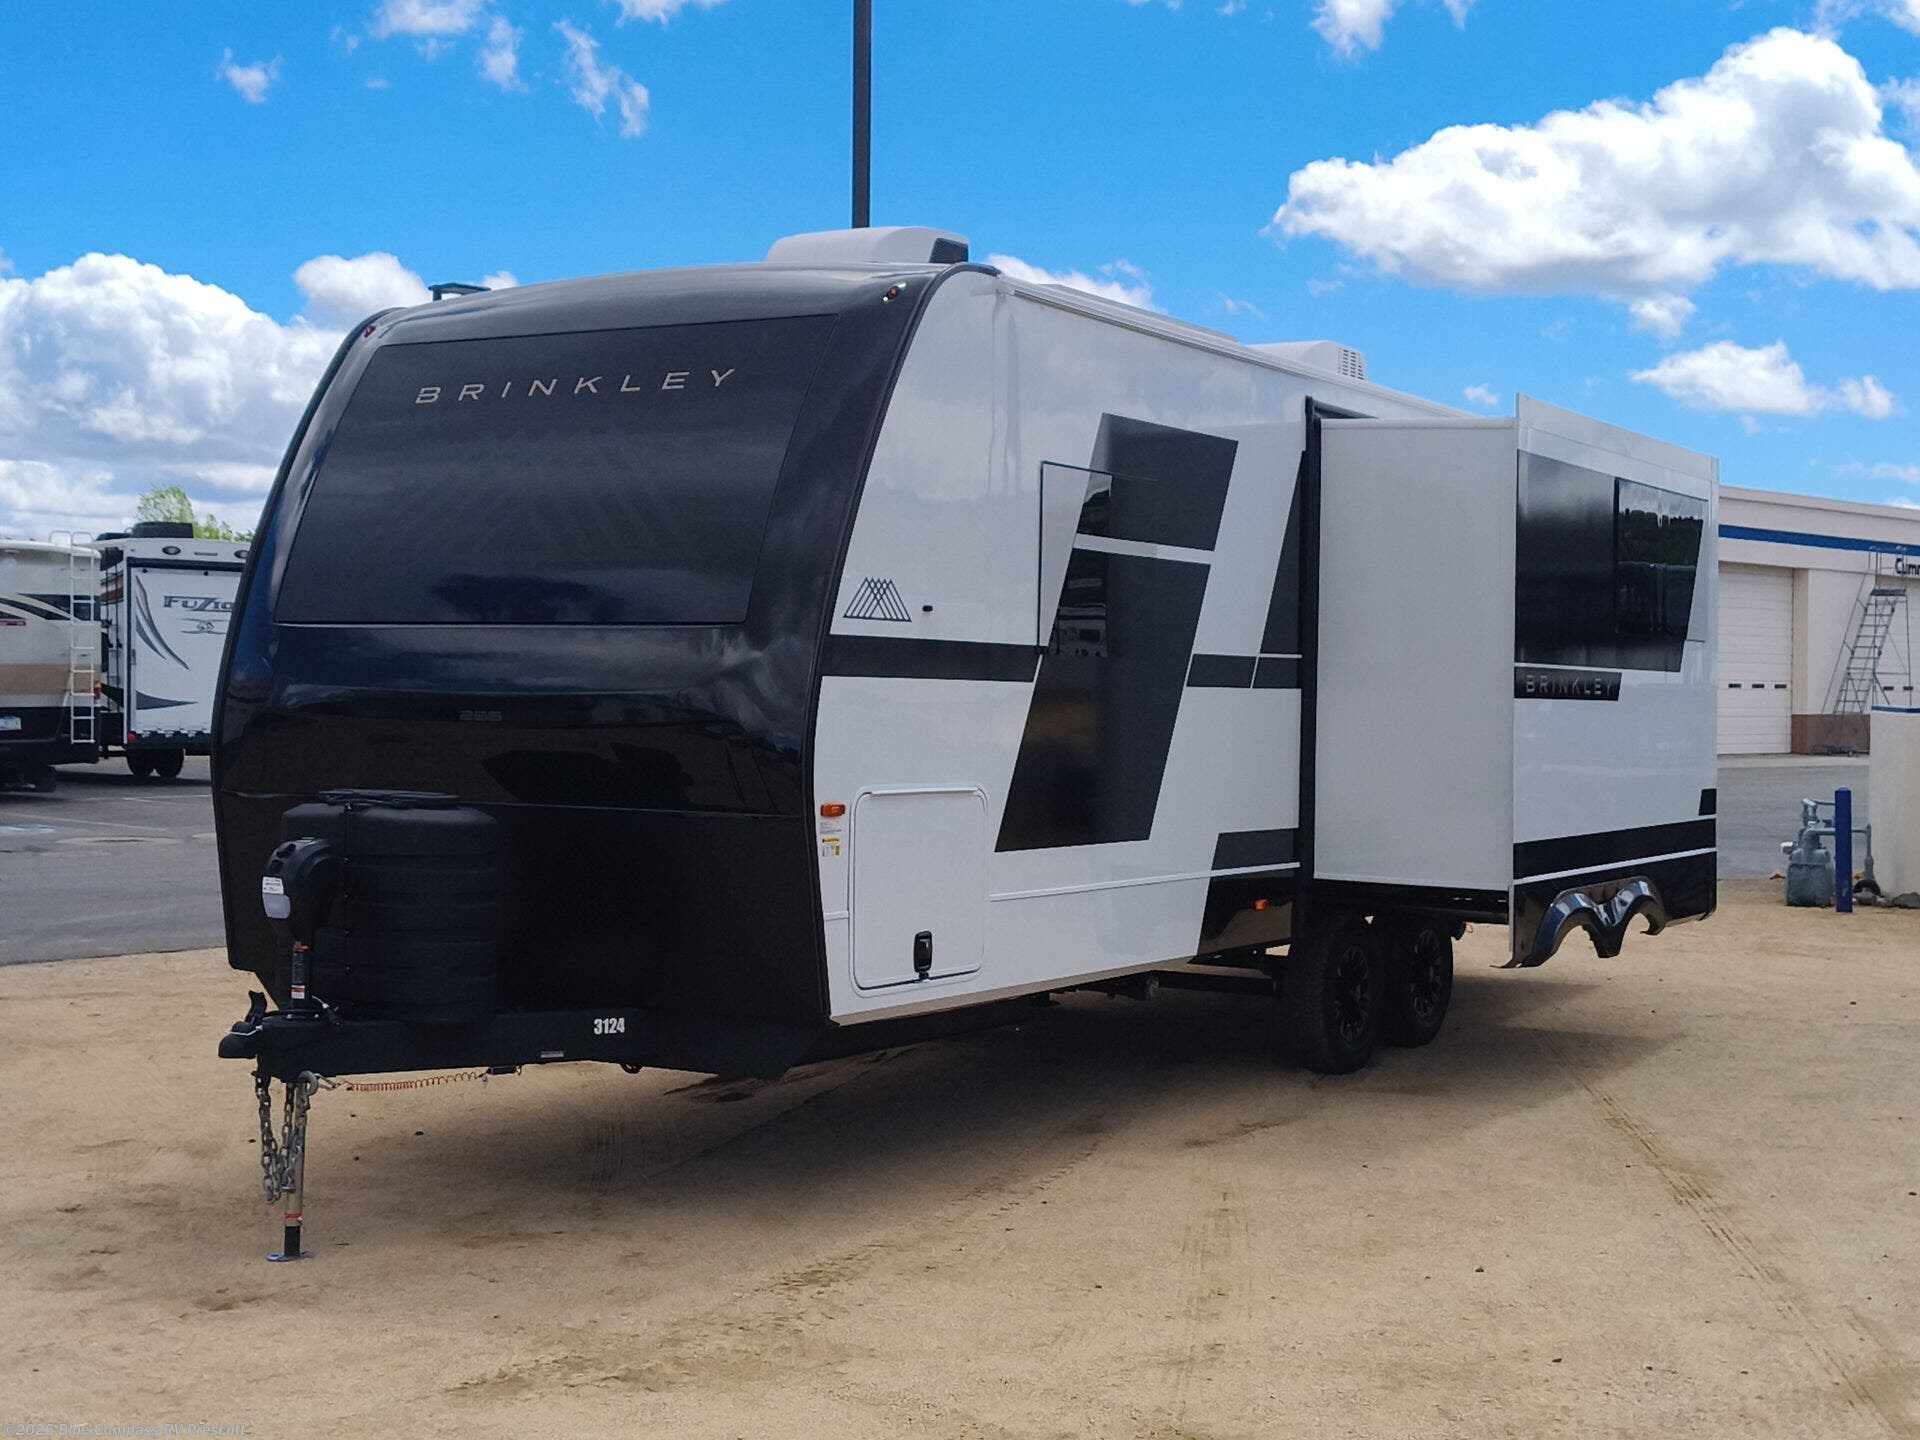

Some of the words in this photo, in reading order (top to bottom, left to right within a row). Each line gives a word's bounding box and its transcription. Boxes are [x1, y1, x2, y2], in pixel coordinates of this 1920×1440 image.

[415, 368, 735, 404] BRINKLEY
[1525, 674, 1614, 695] BRINKLEY
[593, 1017, 625, 1035] 3124
